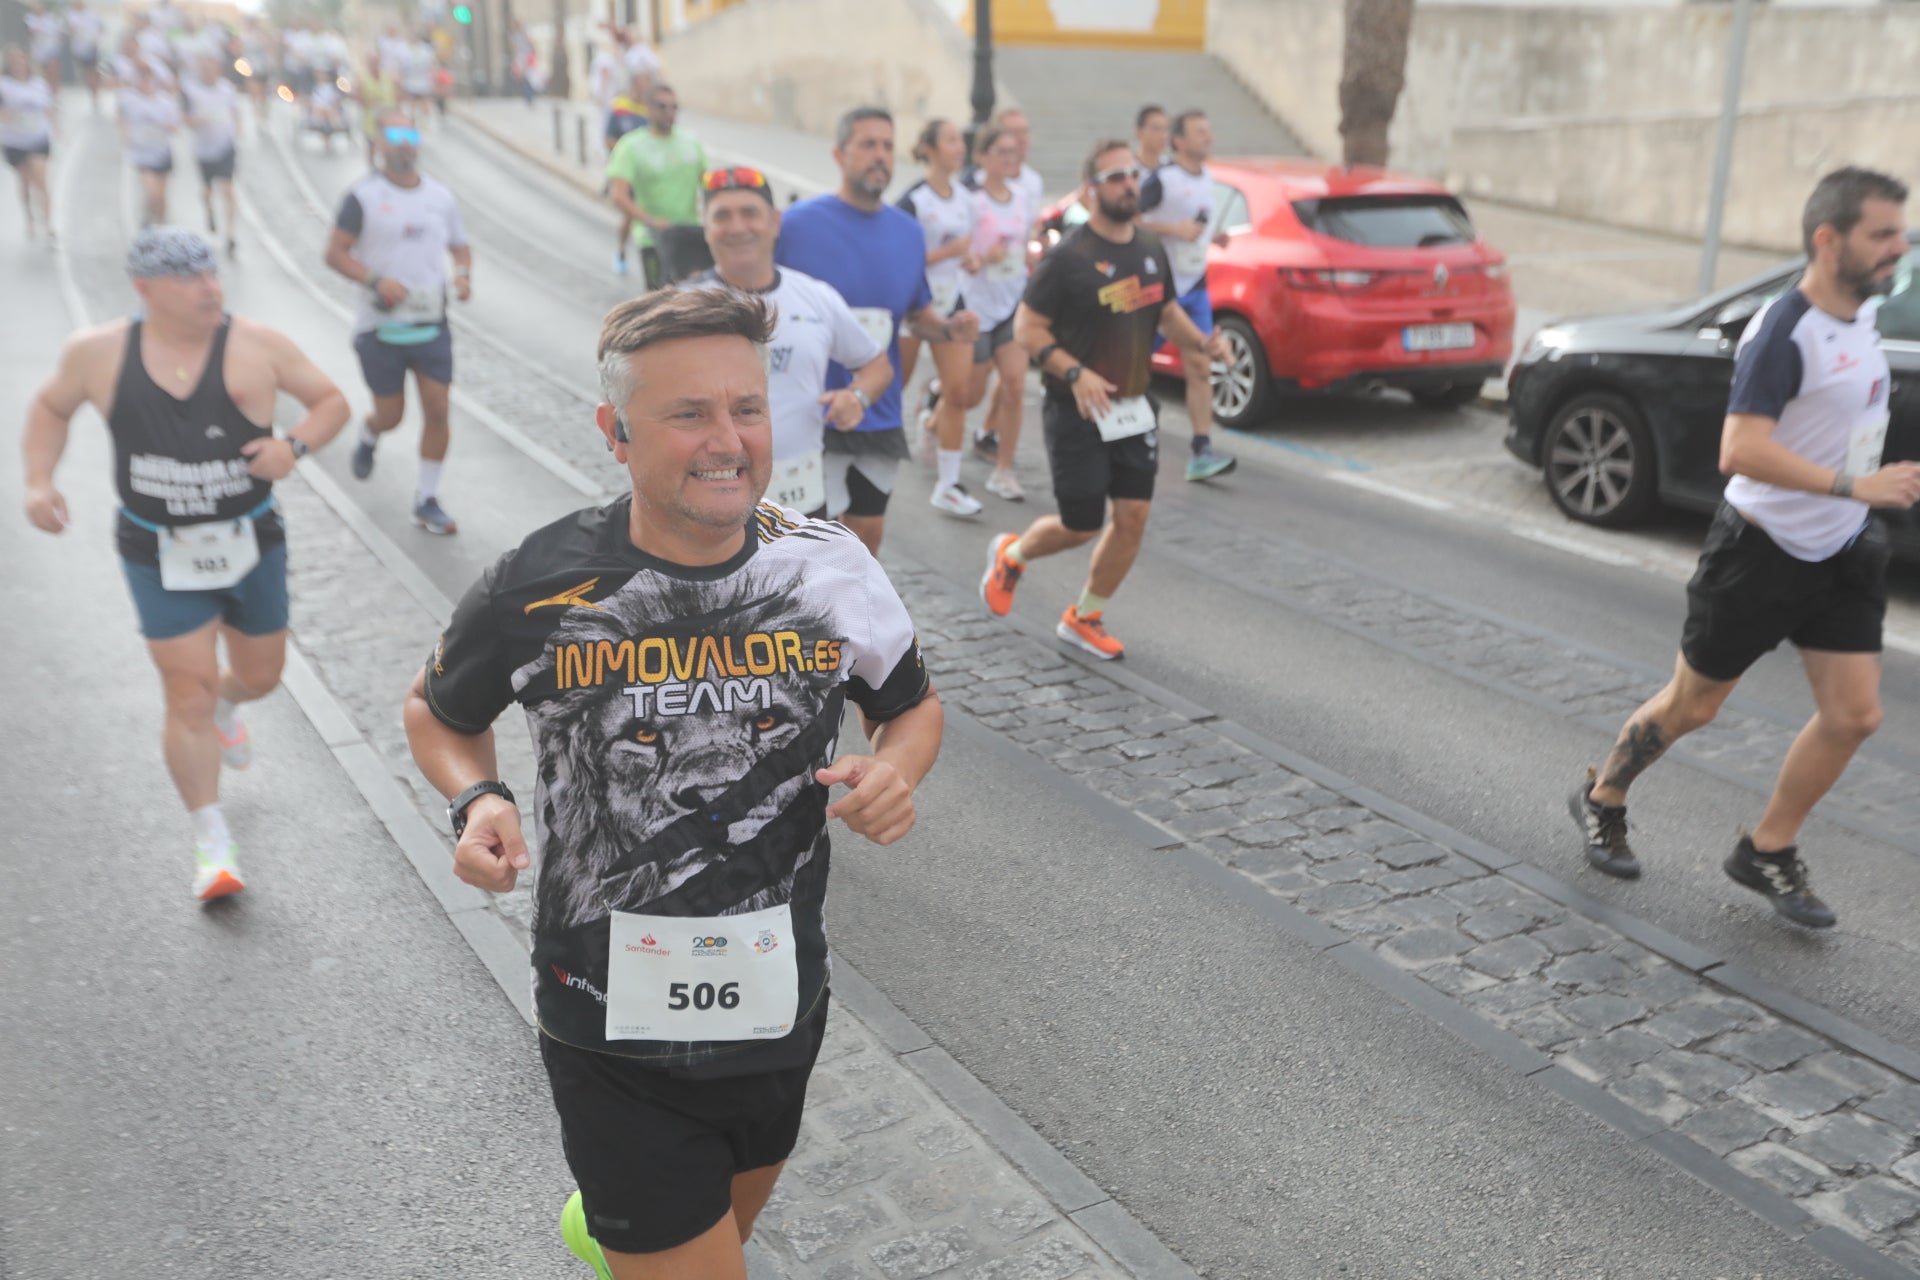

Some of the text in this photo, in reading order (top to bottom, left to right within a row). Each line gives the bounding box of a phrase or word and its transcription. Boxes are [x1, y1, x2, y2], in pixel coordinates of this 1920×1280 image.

[556, 631, 842, 689] INMOVALOR.ES
[623, 678, 772, 718] TEAM
[625, 944, 671, 957] Santander
[692, 936, 728, 948] 200
[668, 982, 740, 1011] 506
